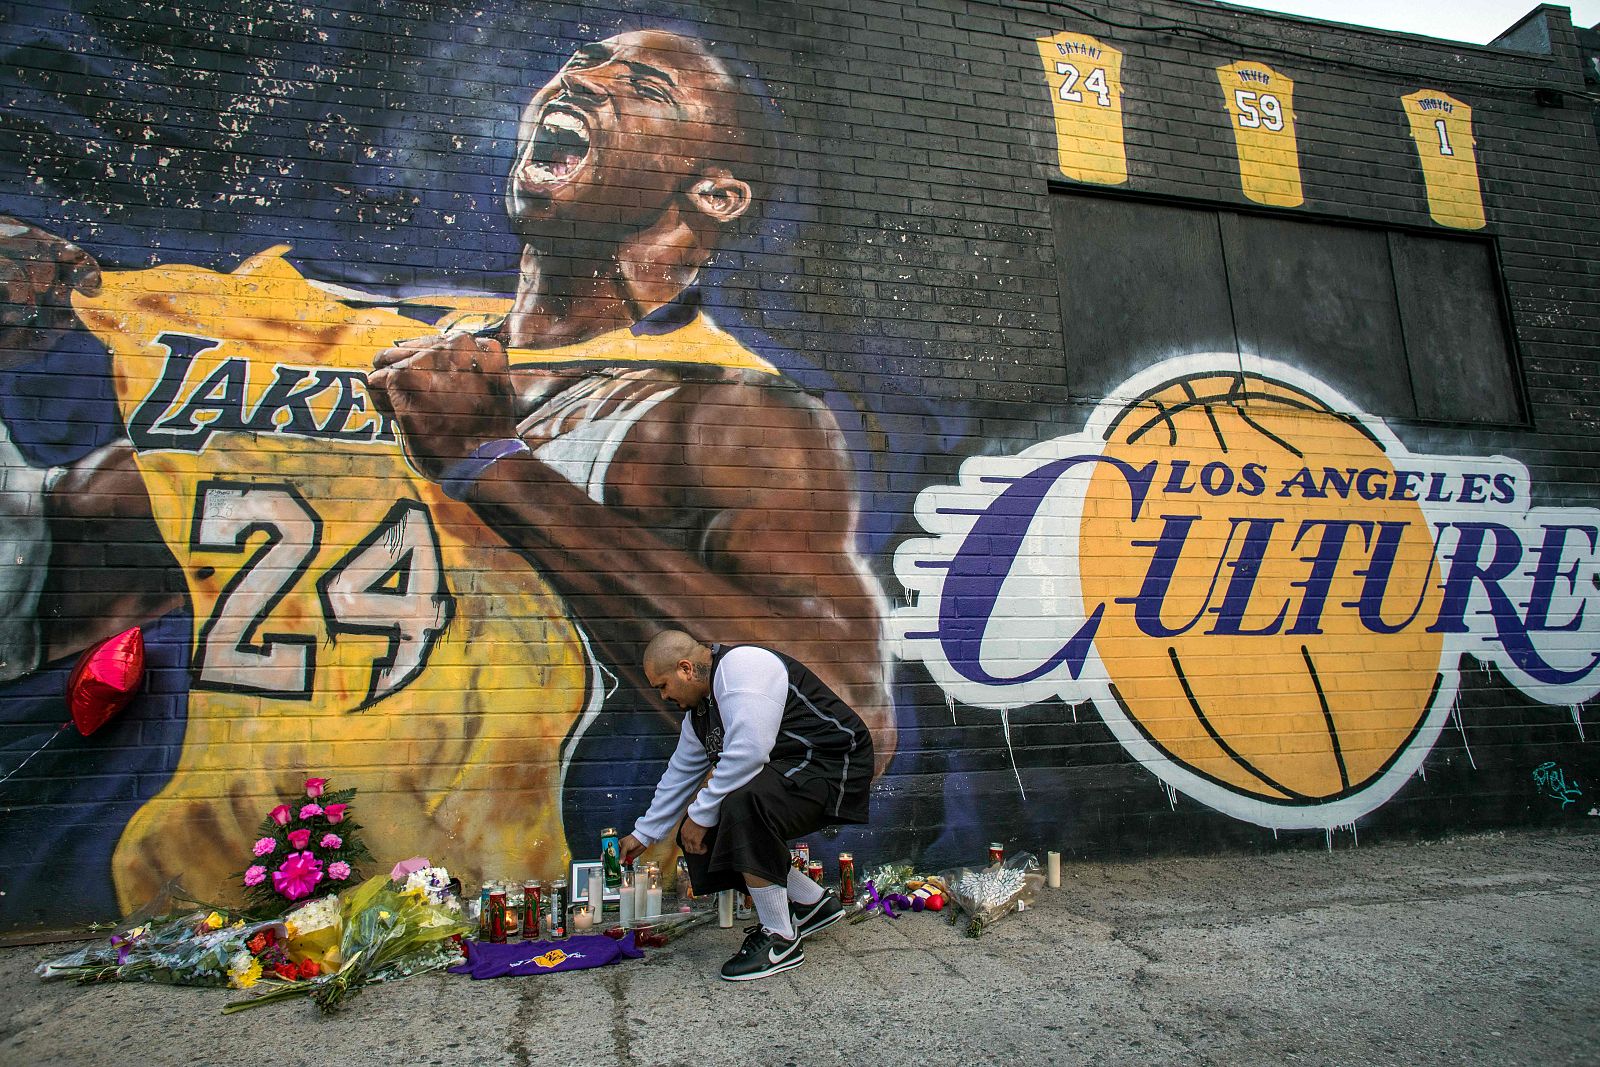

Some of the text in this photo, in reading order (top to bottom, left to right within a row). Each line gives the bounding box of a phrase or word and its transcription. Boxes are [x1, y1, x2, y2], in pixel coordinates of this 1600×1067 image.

[1057, 42, 1102, 60] BRYANT
[1056, 62, 1111, 107] 24
[1234, 89, 1284, 132] 59
[1435, 119, 1454, 156] 1
[1163, 460, 1516, 503] LOS ANGELES
[905, 454, 1600, 685] CULTURE
[188, 480, 457, 713] 24
